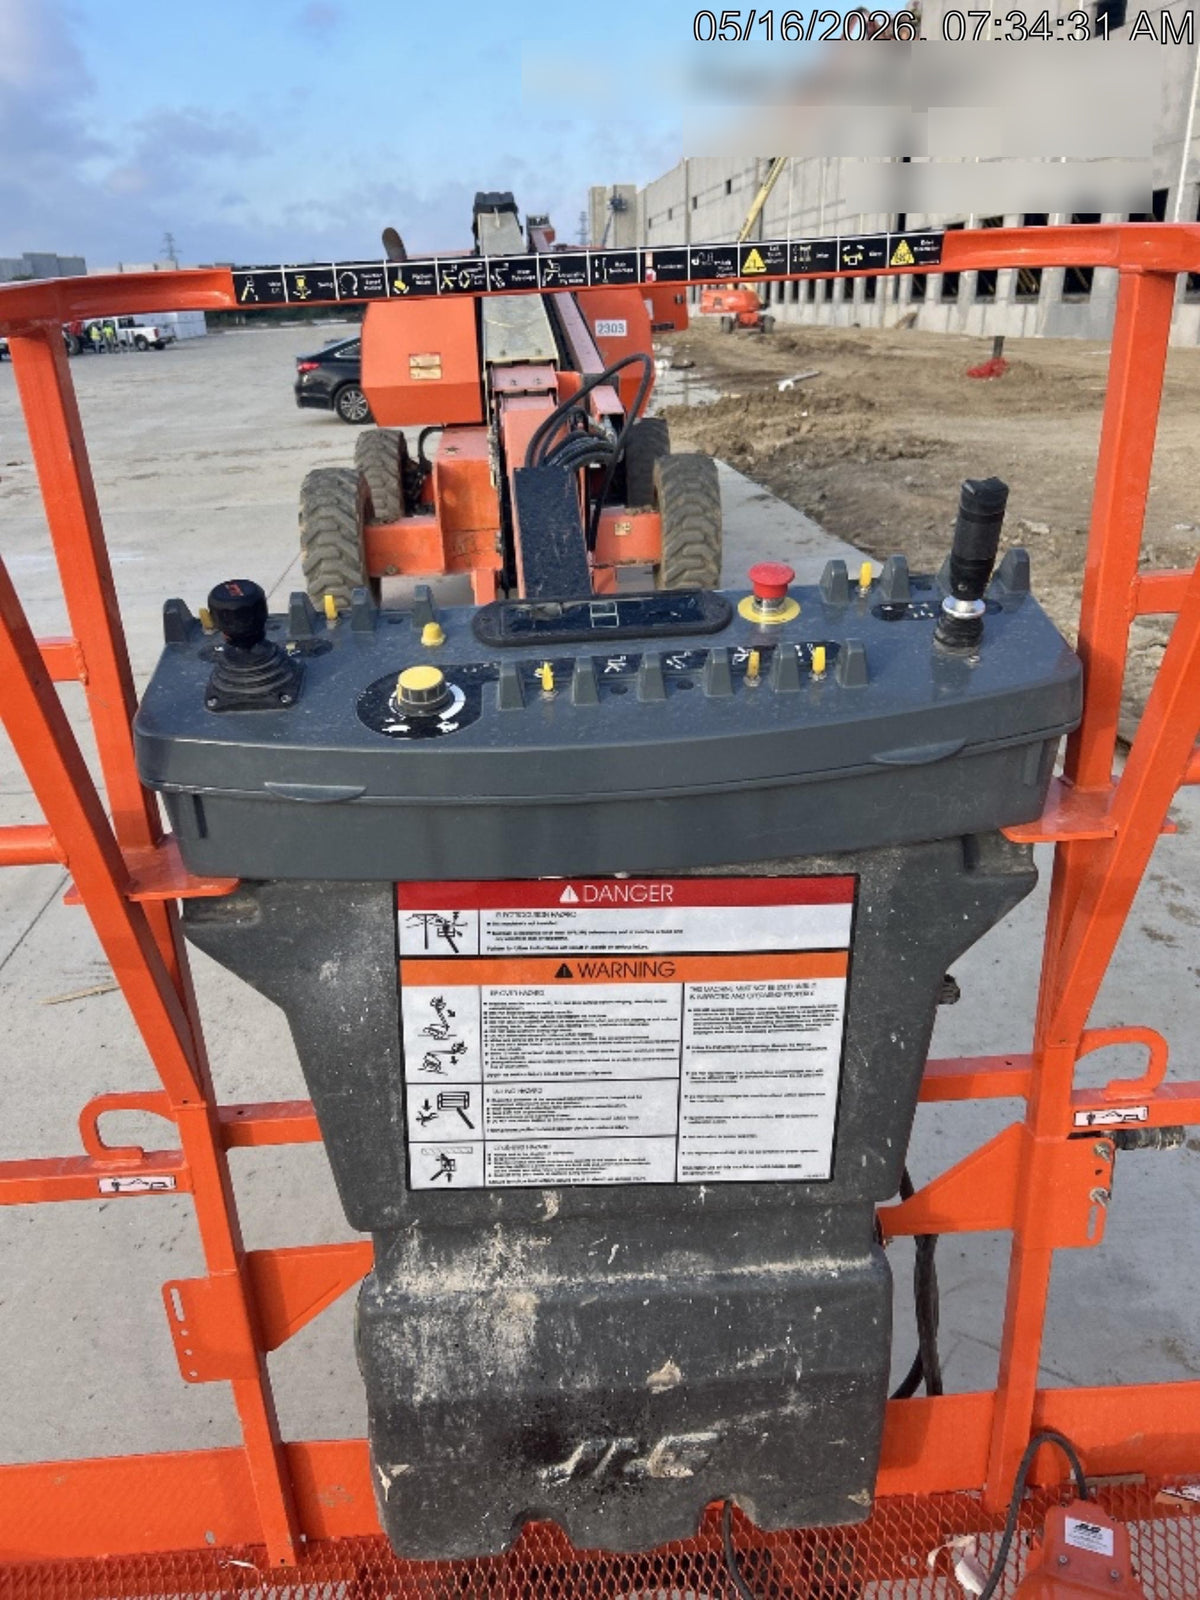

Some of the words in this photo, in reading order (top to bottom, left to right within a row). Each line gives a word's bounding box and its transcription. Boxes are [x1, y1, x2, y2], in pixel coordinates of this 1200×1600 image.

[597, 322, 625, 335] 2303
[583, 884, 674, 903] DANGER
[577, 961, 676, 979] WARNING
